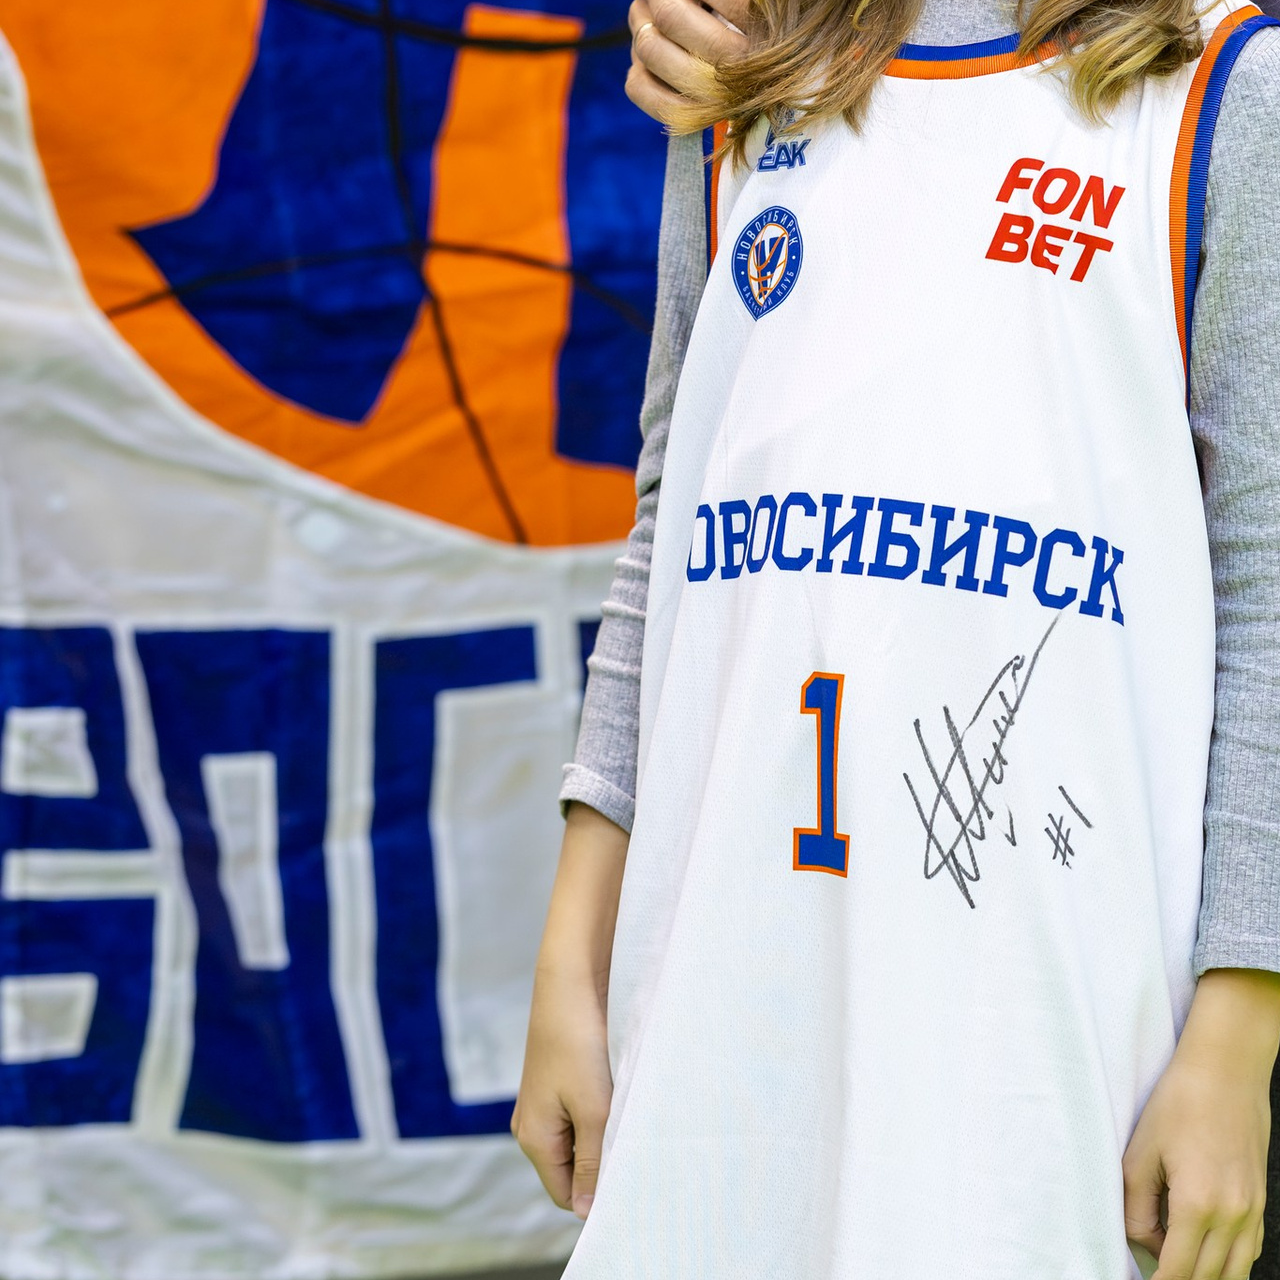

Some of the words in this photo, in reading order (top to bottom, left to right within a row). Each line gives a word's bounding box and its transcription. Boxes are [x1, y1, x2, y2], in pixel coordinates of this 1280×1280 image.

[757, 138, 811, 173] EAK
[995, 157, 1126, 229] FON
[985, 213, 1114, 283] BET
[686, 491, 1125, 627] ОВОСИБИРСК
[792, 670, 850, 878] 1
[1043, 784, 1094, 869] #1
